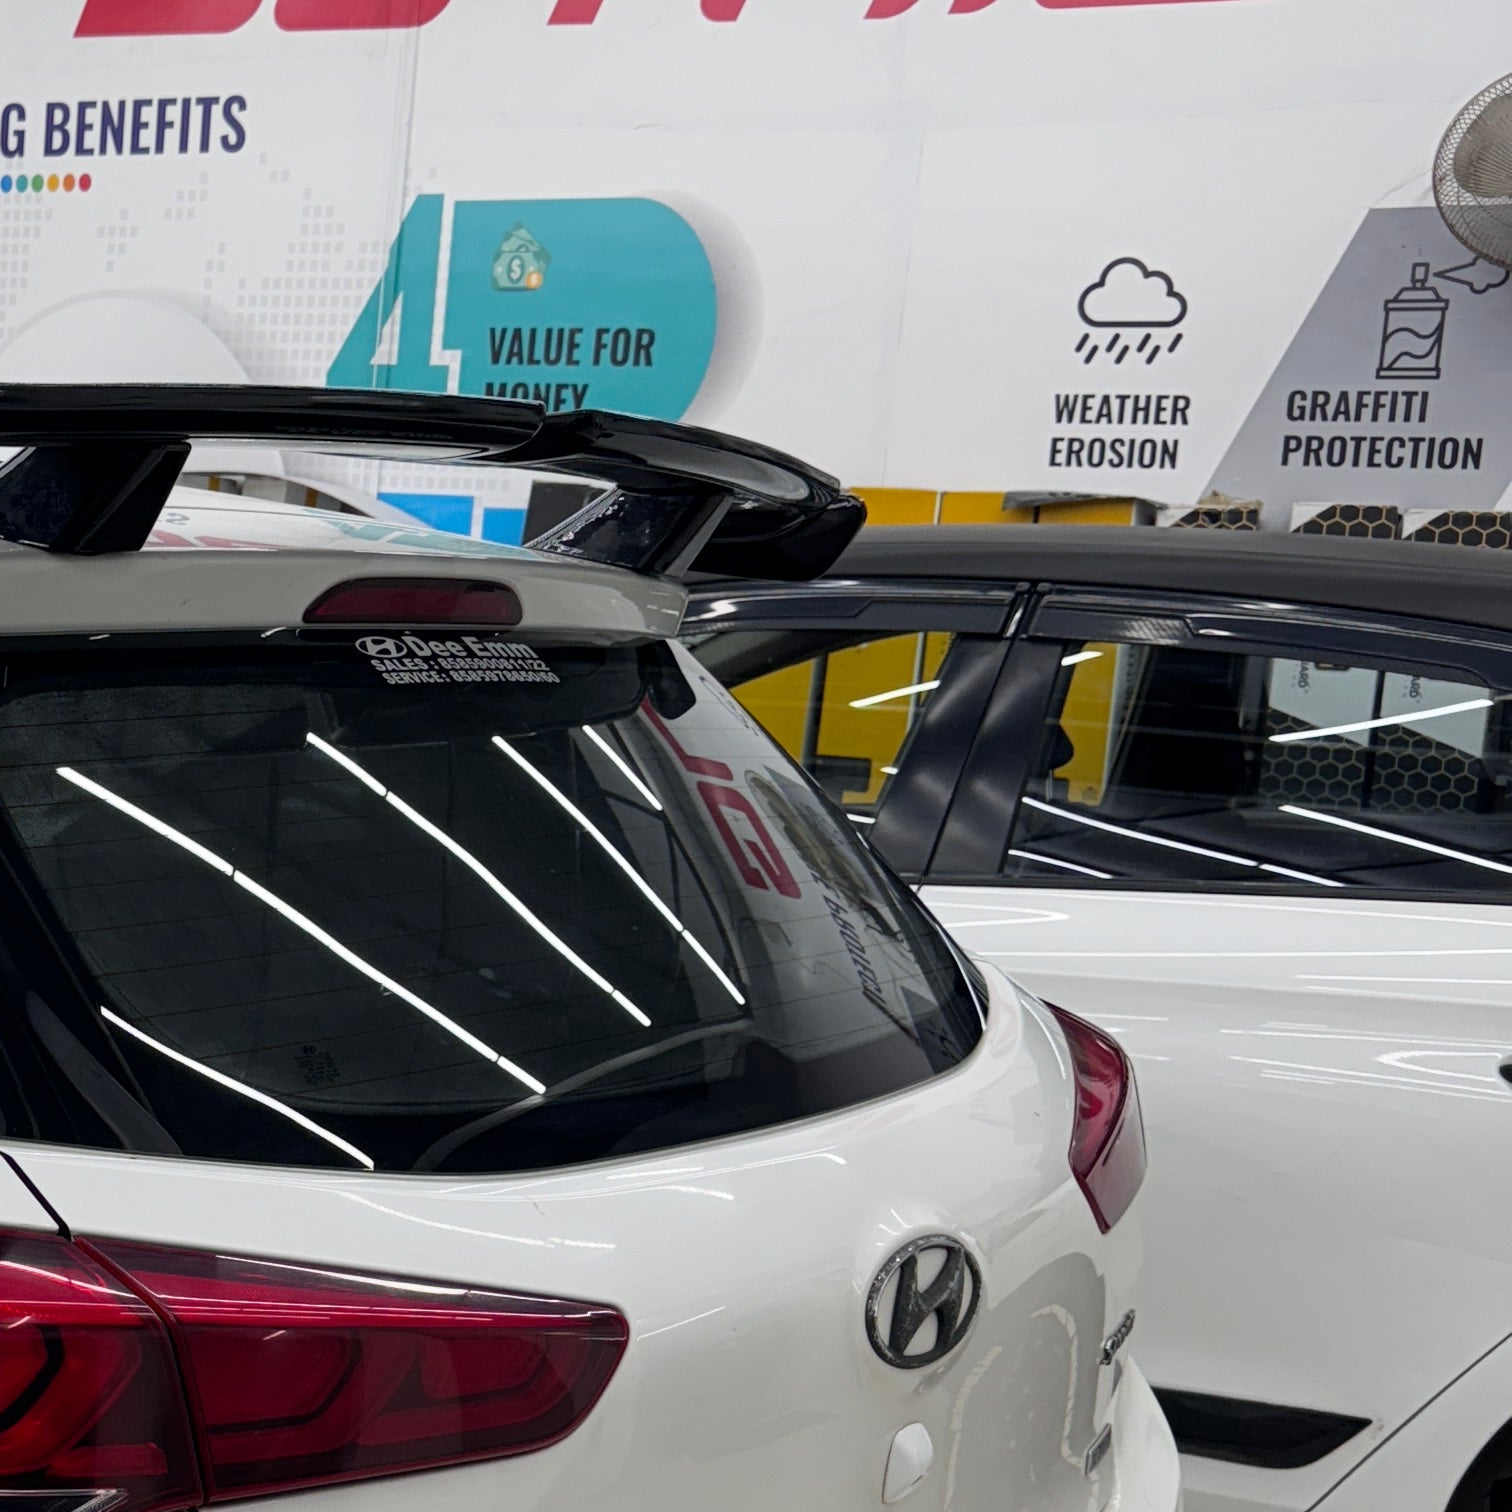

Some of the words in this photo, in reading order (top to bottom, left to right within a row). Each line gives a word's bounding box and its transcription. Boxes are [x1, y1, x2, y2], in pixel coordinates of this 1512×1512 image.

[42, 95, 248, 157] BENEFITS
[488, 327, 584, 367] VALUE
[592, 328, 656, 367] FOR
[1054, 394, 1192, 427] WEATHER
[1286, 390, 1430, 423] GRAFFITI
[1048, 437, 1180, 470] EROSION
[1280, 435, 1484, 471] PROTECTION
[401, 635, 467, 657] Dee
[461, 636, 538, 658] Emm
[371, 658, 428, 672] SALES
